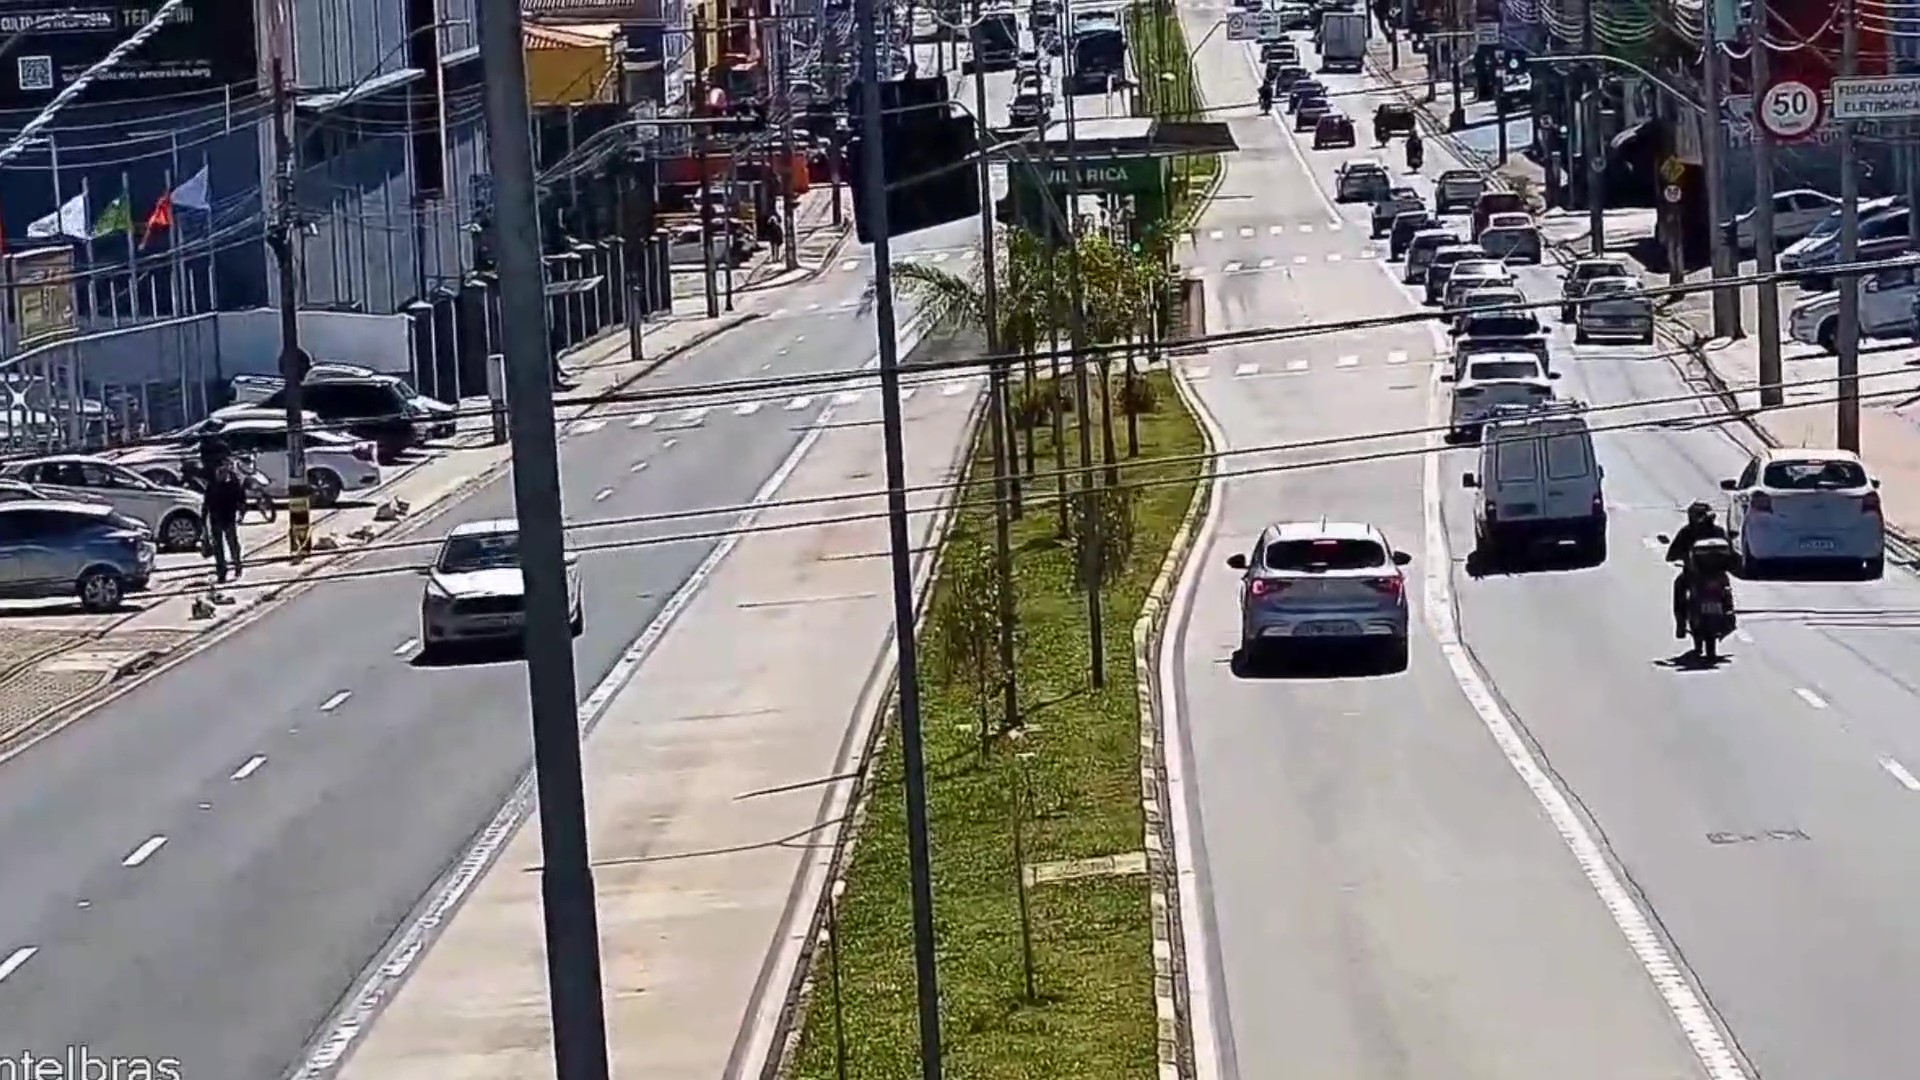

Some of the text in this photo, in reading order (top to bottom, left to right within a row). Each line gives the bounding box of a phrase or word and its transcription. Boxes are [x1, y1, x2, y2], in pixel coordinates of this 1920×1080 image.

[1838, 81, 1920, 96] FISCALIZAÇÃ
[1772, 91, 1808, 116] 50
[1844, 98, 1920, 114] ELETRÔNICA
[1085, 166, 1129, 182] RICA
